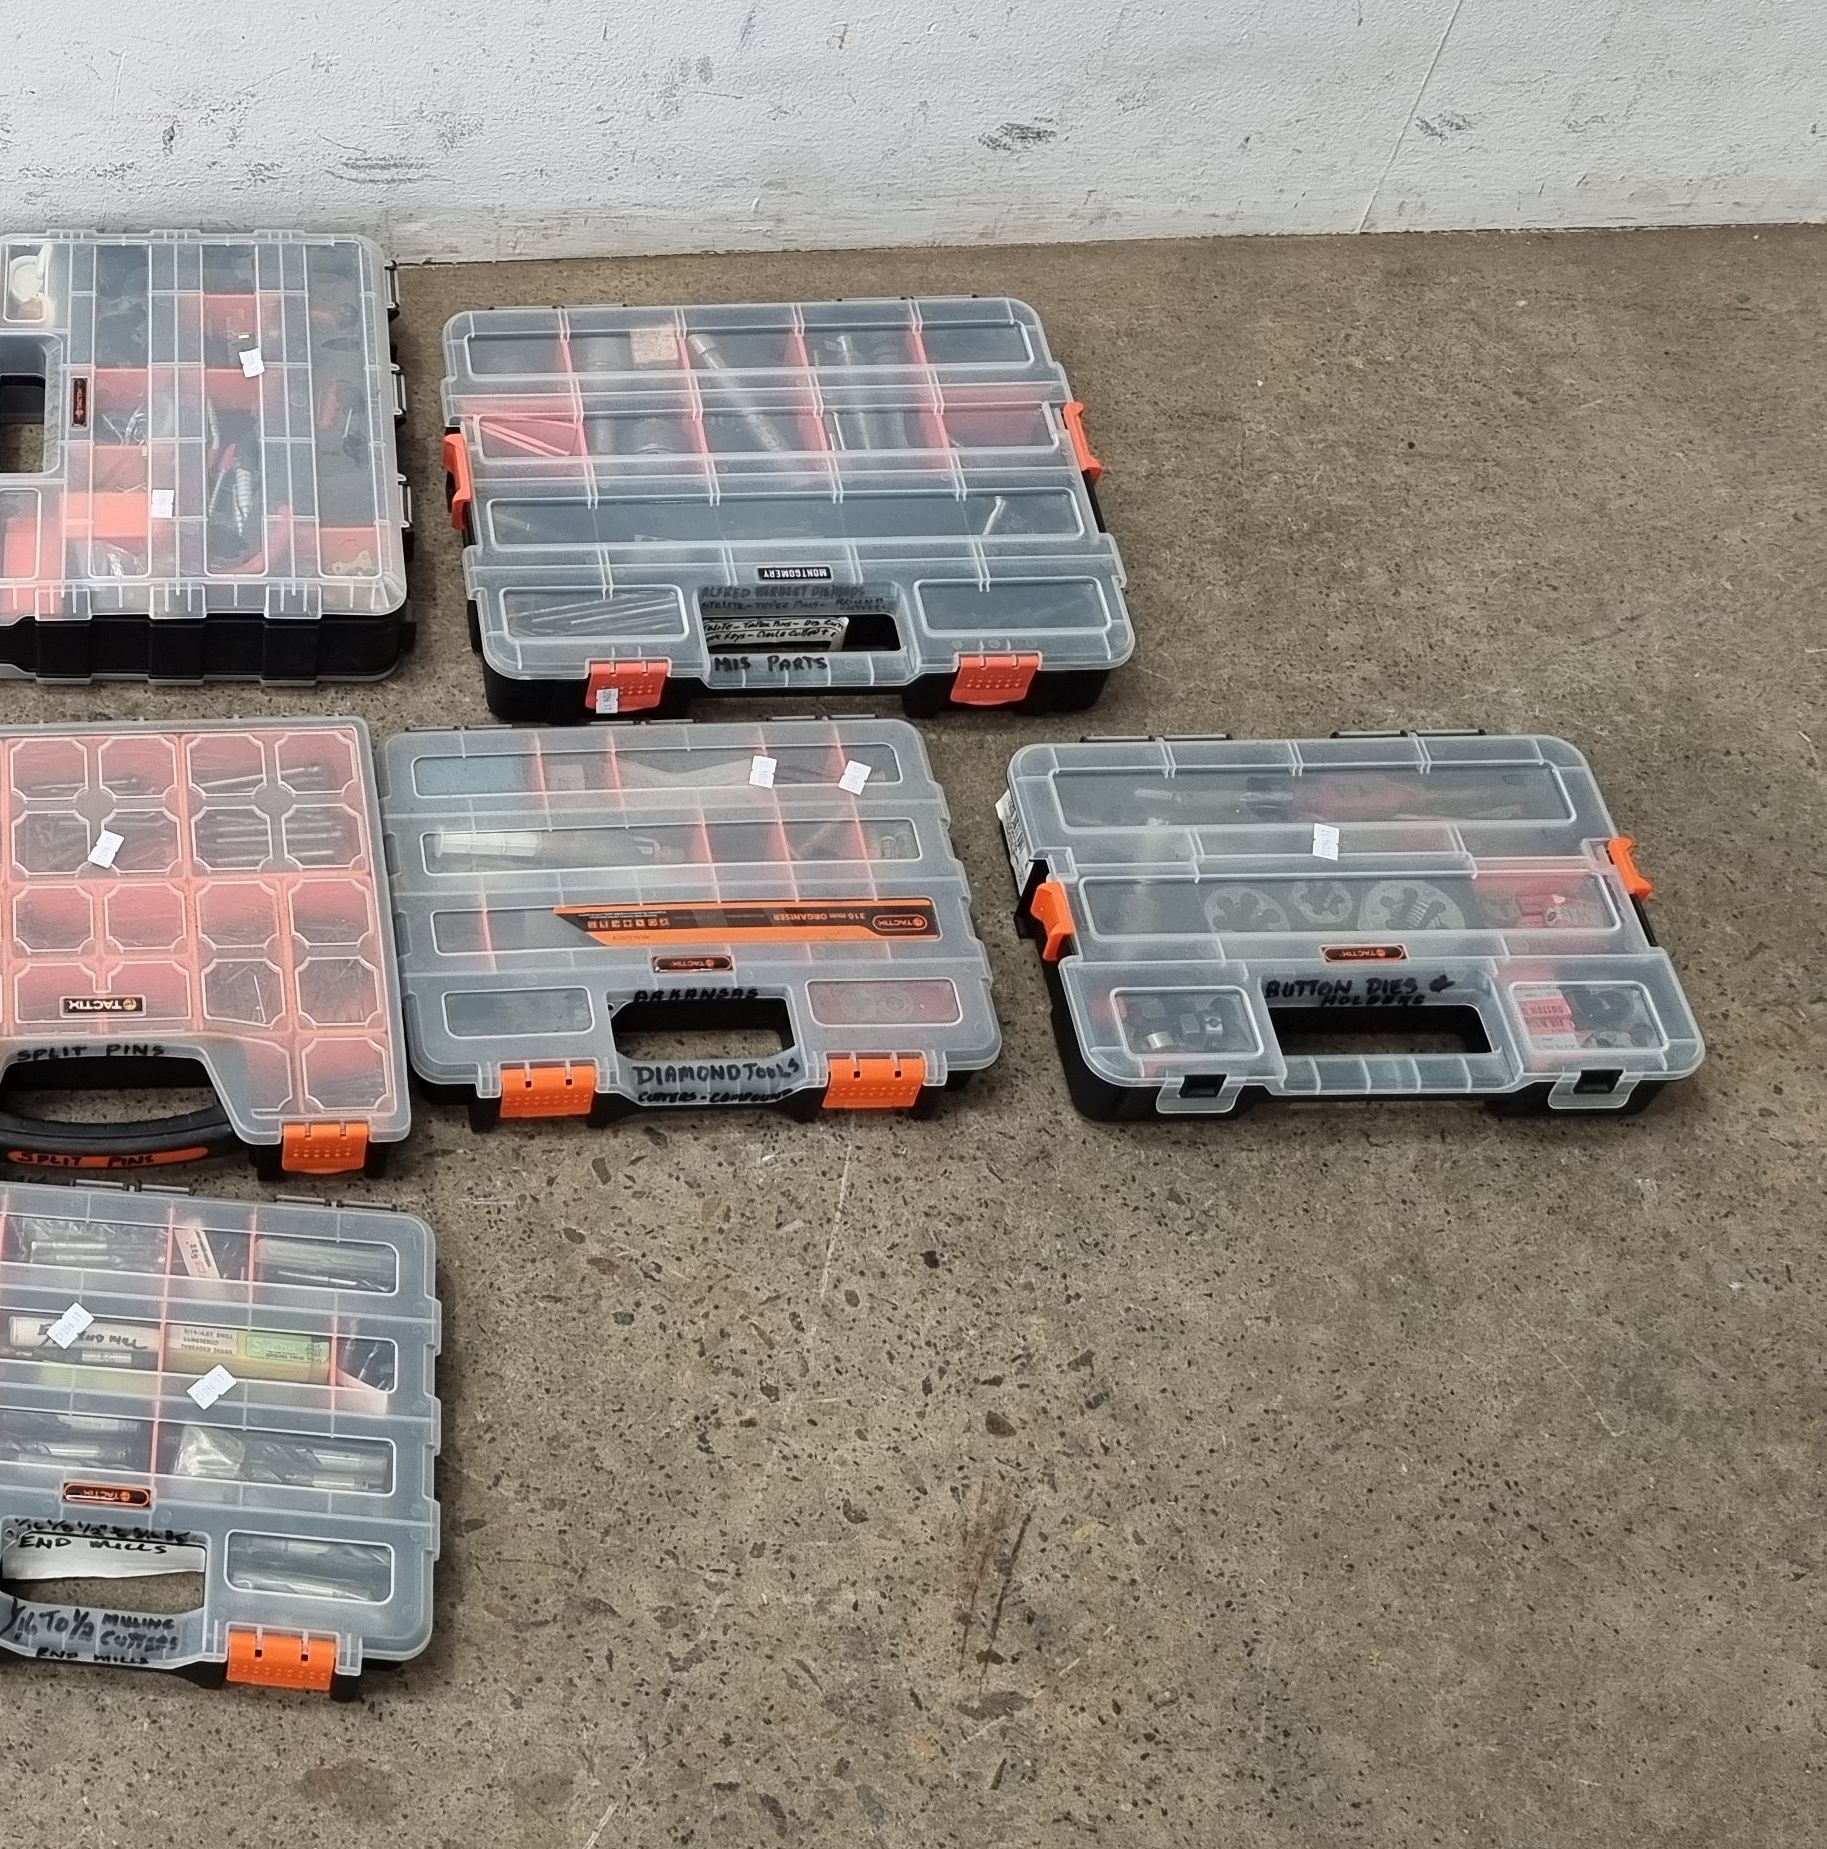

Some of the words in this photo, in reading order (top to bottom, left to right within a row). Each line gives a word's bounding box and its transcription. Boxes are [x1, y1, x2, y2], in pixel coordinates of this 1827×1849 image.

[763, 568, 828, 579] MONTGOMERY
[766, 655, 828, 672] PARTS
[772, 912, 828, 922] ORGANISER
[877, 919, 913, 928] TACTIX
[633, 988, 759, 1002] ARKANSAS
[1264, 979, 1353, 999] BUTTON
[1366, 976, 1419, 995] DIES
[68, 999, 123, 1011] TACTIX
[17, 1046, 87, 1062] SPLIT
[105, 1043, 165, 1056] PINS
[632, 1064, 742, 1086] DIAMOND
[742, 1057, 800, 1081] TOOLS
[17, 1152, 82, 1166] SPLIT
[107, 1154, 155, 1168] PINS
[18, 1535, 72, 1549] END
[89, 1540, 168, 1555] MILLS
[39, 1610, 69, 1632] TO
[101, 1613, 175, 1630] MILLING
